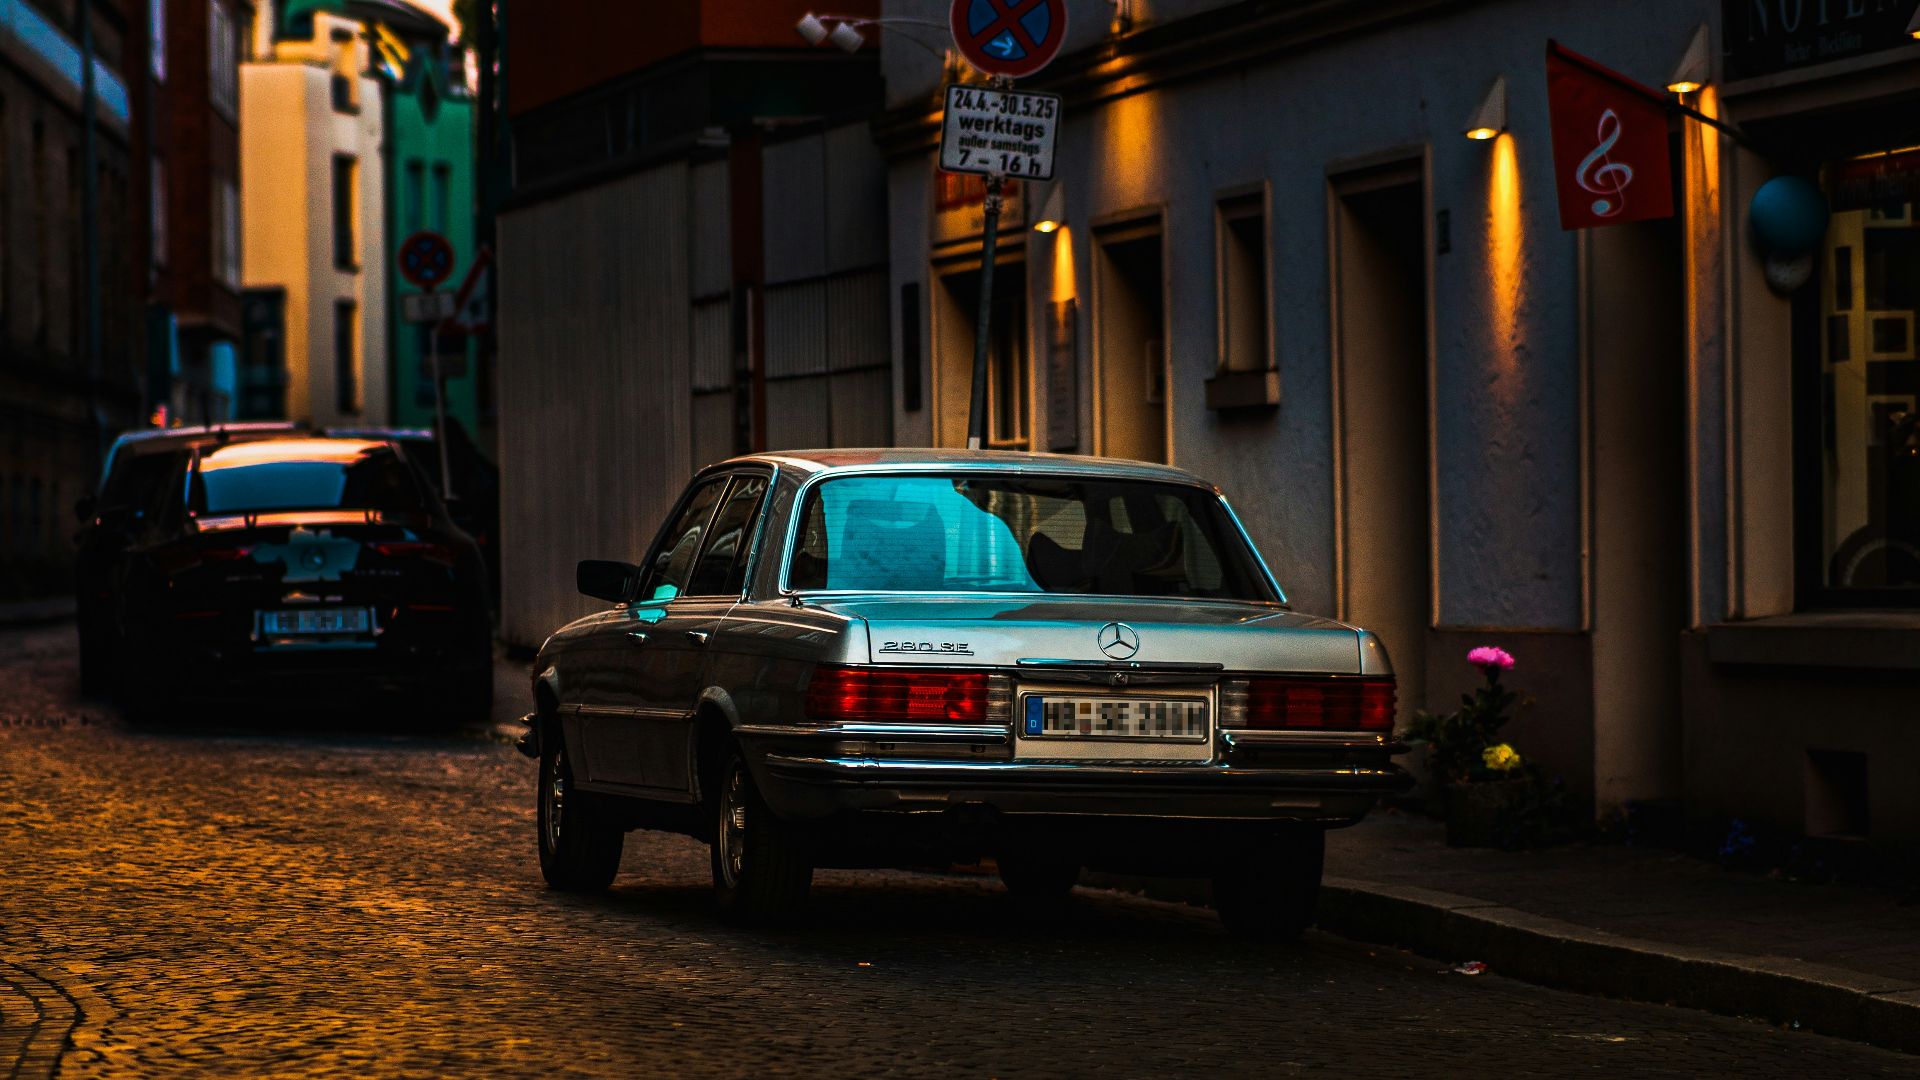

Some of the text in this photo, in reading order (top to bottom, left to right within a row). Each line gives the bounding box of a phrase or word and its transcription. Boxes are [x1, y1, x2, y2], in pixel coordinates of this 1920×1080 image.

[959, 116, 1044, 141] werktags
[959, 135, 1039, 156] außer samstags
[959, 149, 970, 166] 7
[1001, 153, 1021, 173] 16
[1029, 158, 1041, 176] h
[884, 641, 969, 653] 280 SE
[1030, 719, 1037, 728] D
